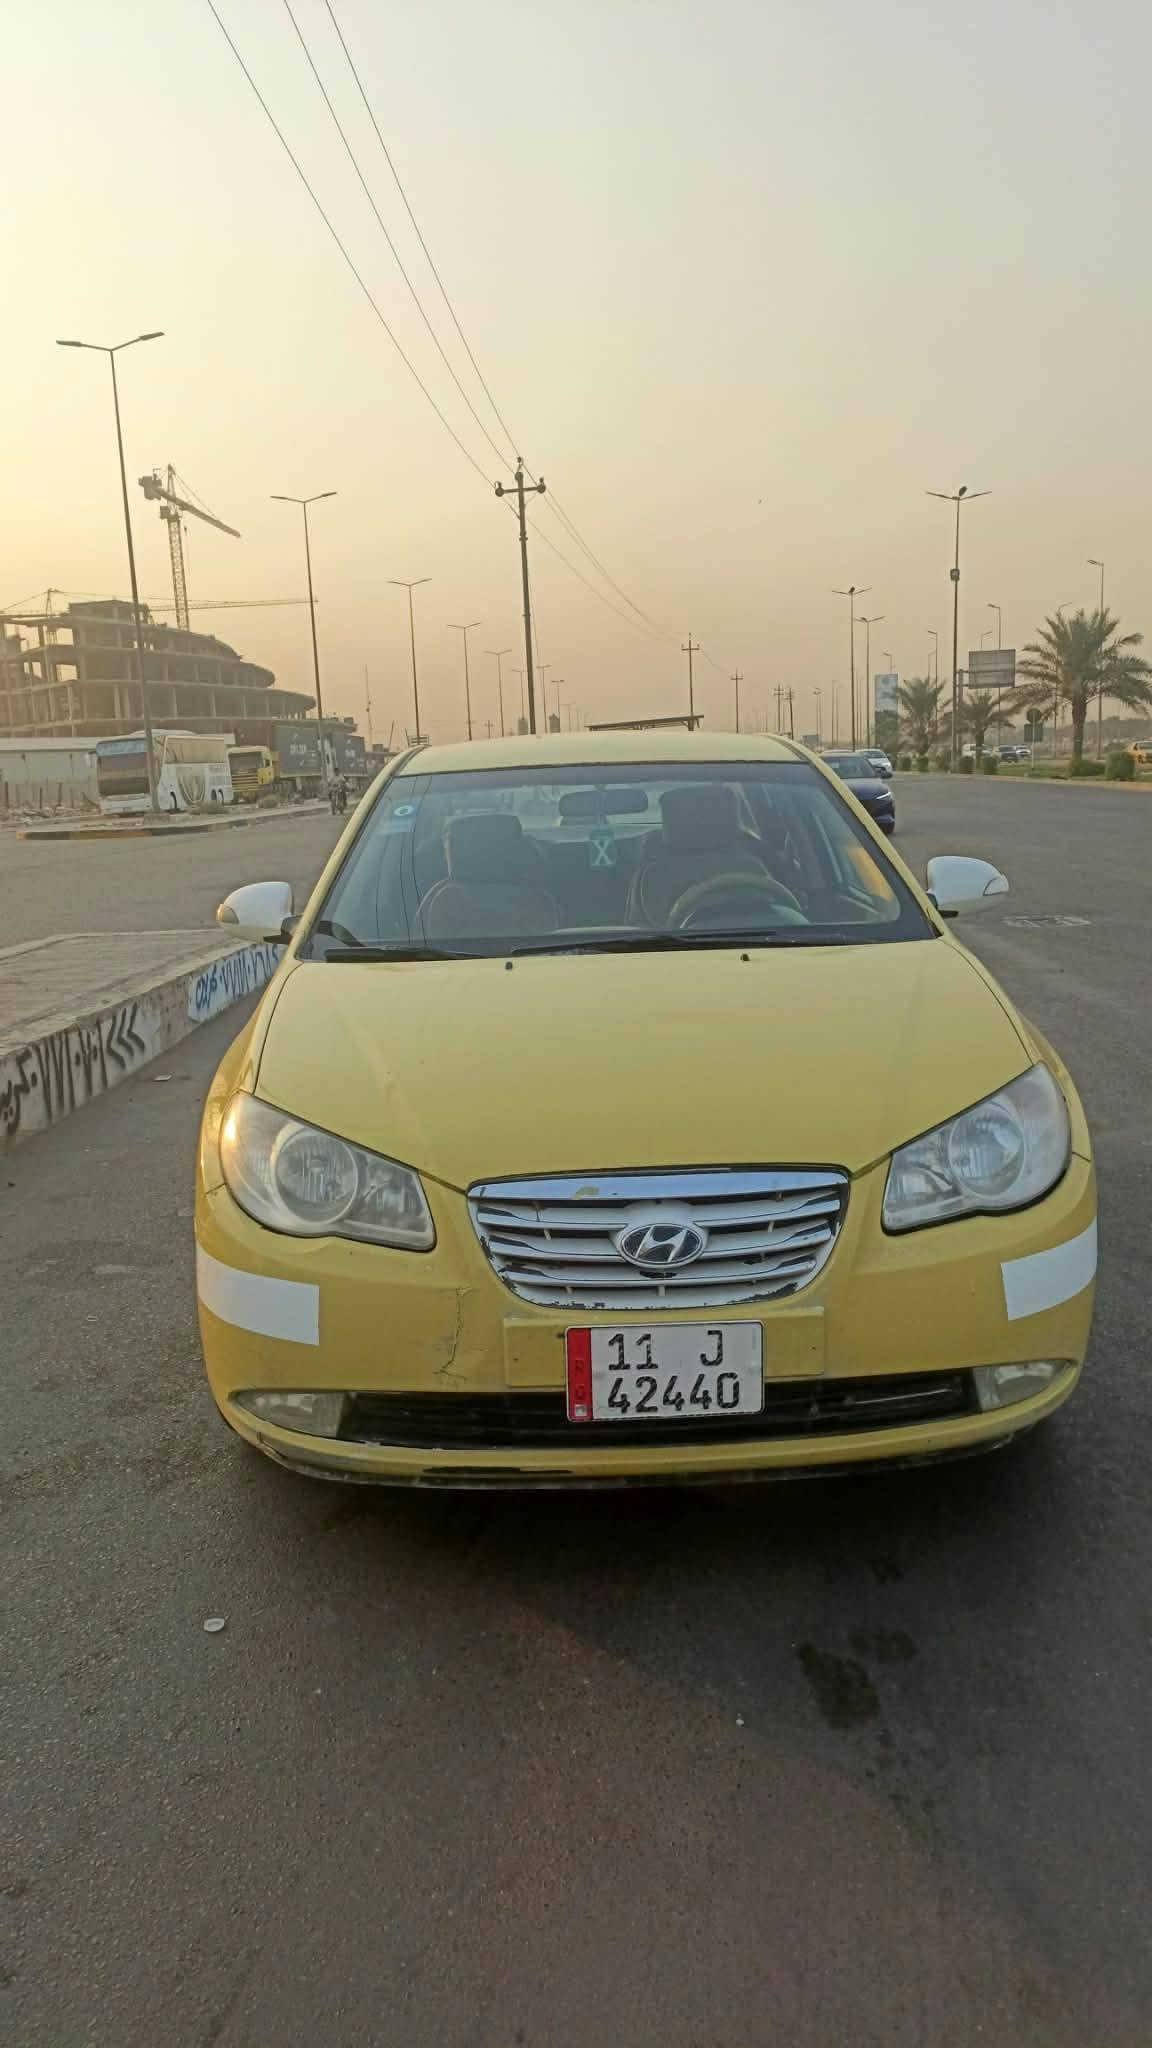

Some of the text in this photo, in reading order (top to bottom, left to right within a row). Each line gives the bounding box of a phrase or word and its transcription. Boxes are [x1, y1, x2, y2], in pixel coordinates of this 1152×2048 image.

[608, 1330, 723, 1370] 11 J
[608, 1372, 740, 1414] 42440
